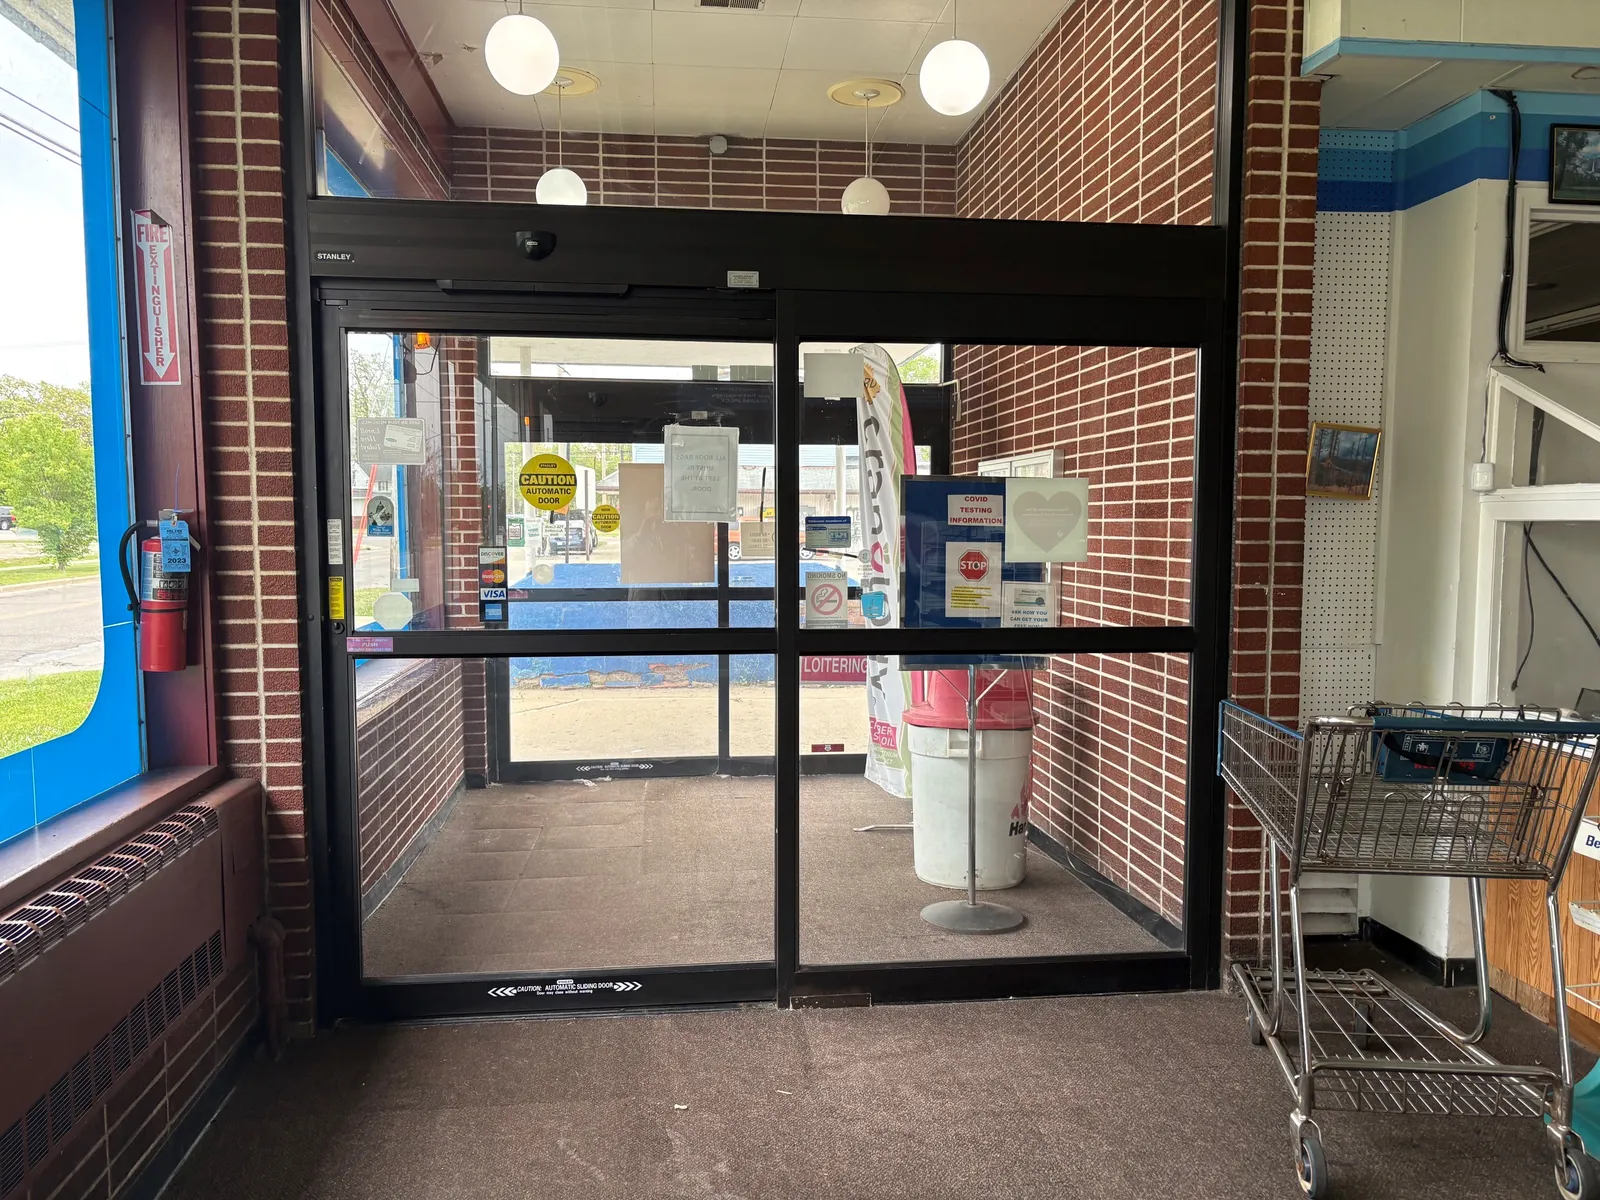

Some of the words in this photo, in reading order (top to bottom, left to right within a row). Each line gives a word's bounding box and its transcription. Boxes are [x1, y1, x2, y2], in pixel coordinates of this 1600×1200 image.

[137, 224, 168, 243] FIRE
[148, 245, 165, 367] EXTINGUISHER
[521, 475, 575, 485] CAUTION
[960, 561, 987, 569] STOP
[483, 590, 505, 598] VISA
[804, 657, 868, 673] LOITERING
[545, 983, 576, 991] AUTOMATIC
